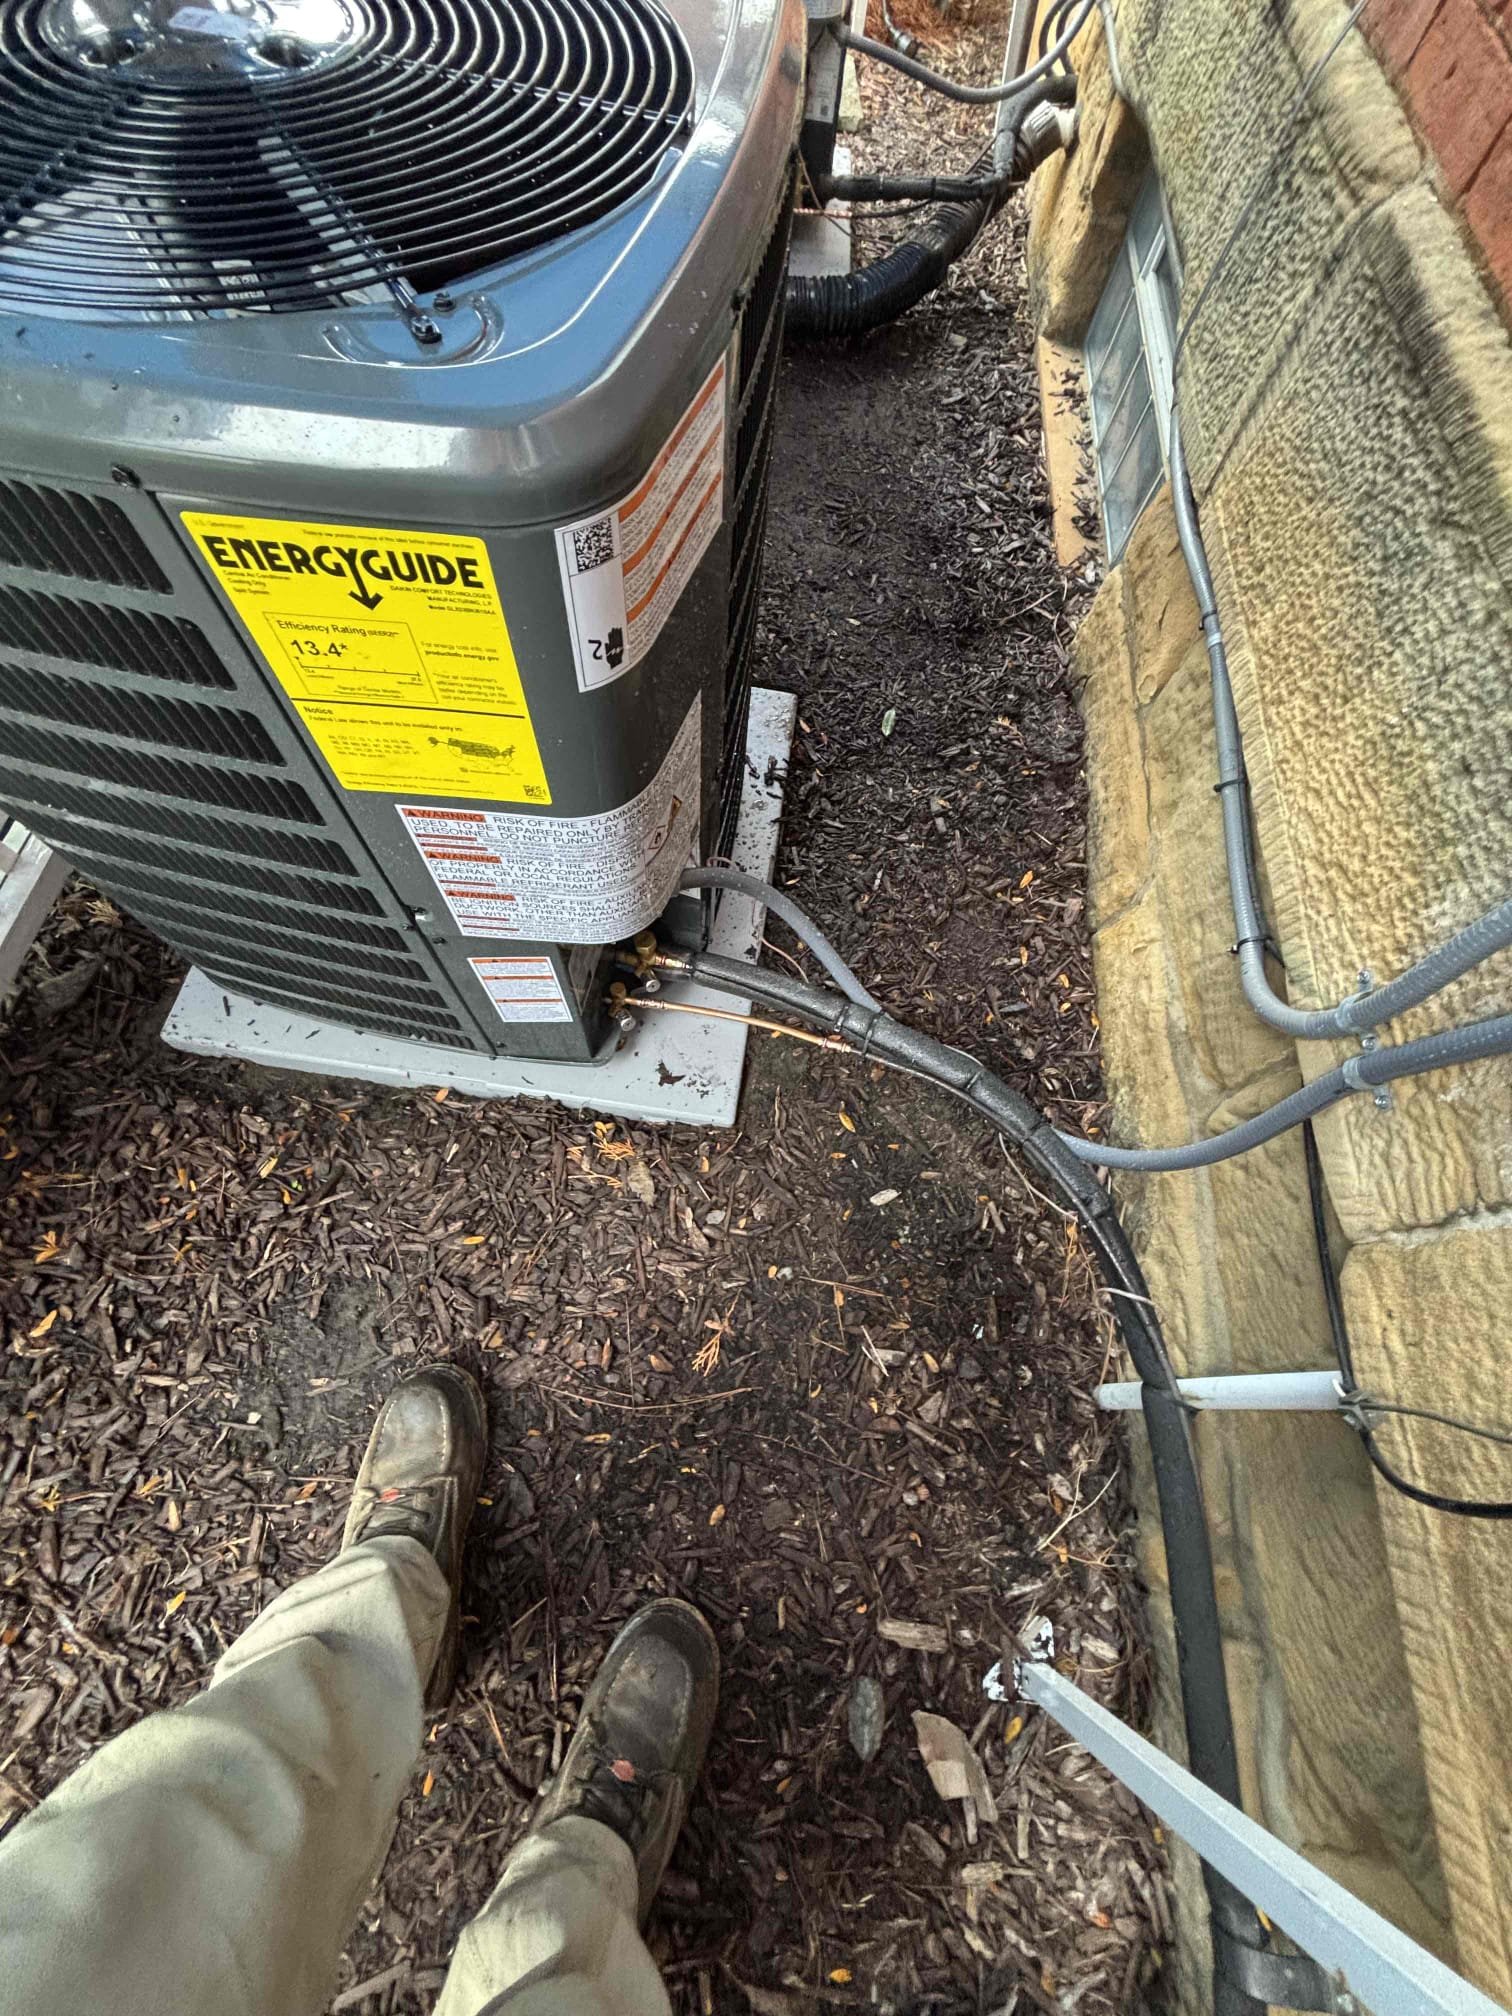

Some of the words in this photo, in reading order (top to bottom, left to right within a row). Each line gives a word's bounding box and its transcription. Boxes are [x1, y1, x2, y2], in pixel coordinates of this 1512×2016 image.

[201, 535, 485, 590] ENERGYGUIDE
[277, 620, 330, 634] Efficiency
[331, 624, 367, 637] Rating
[419, 809, 484, 822] WARNING
[493, 816, 525, 827] RISK
[527, 819, 545, 828] OF
[549, 821, 579, 830] FIRE
[455, 821, 473, 830] TO
[476, 823, 494, 832] BE
[498, 826, 566, 838] REPAIRED
[566, 828, 600, 838] ONLY
[604, 822, 619, 833] BY
[500, 832, 519, 842] DO
[523, 834, 550, 843] NOT
[557, 829, 621, 845] PUNCTURE
[450, 861, 515, 871] PROPERLY
[518, 865, 531, 873] IN
[533, 864, 617, 877] ACCORDANCE
[507, 858, 537, 867] RISK
[539, 860, 555, 868] OF
[559, 861, 586, 869] FIRE
[493, 870, 512, 878] OR
[514, 872, 553, 881] LOCAL
[521, 896, 548, 905] RISK
[551, 898, 567, 906] OF
[570, 900, 596, 908] FIRE
[522, 902, 577, 912] SOURCES
[579, 904, 613, 913] SHALL
[525, 908, 564, 917] OTHER
[568, 910, 597, 918] THAN
